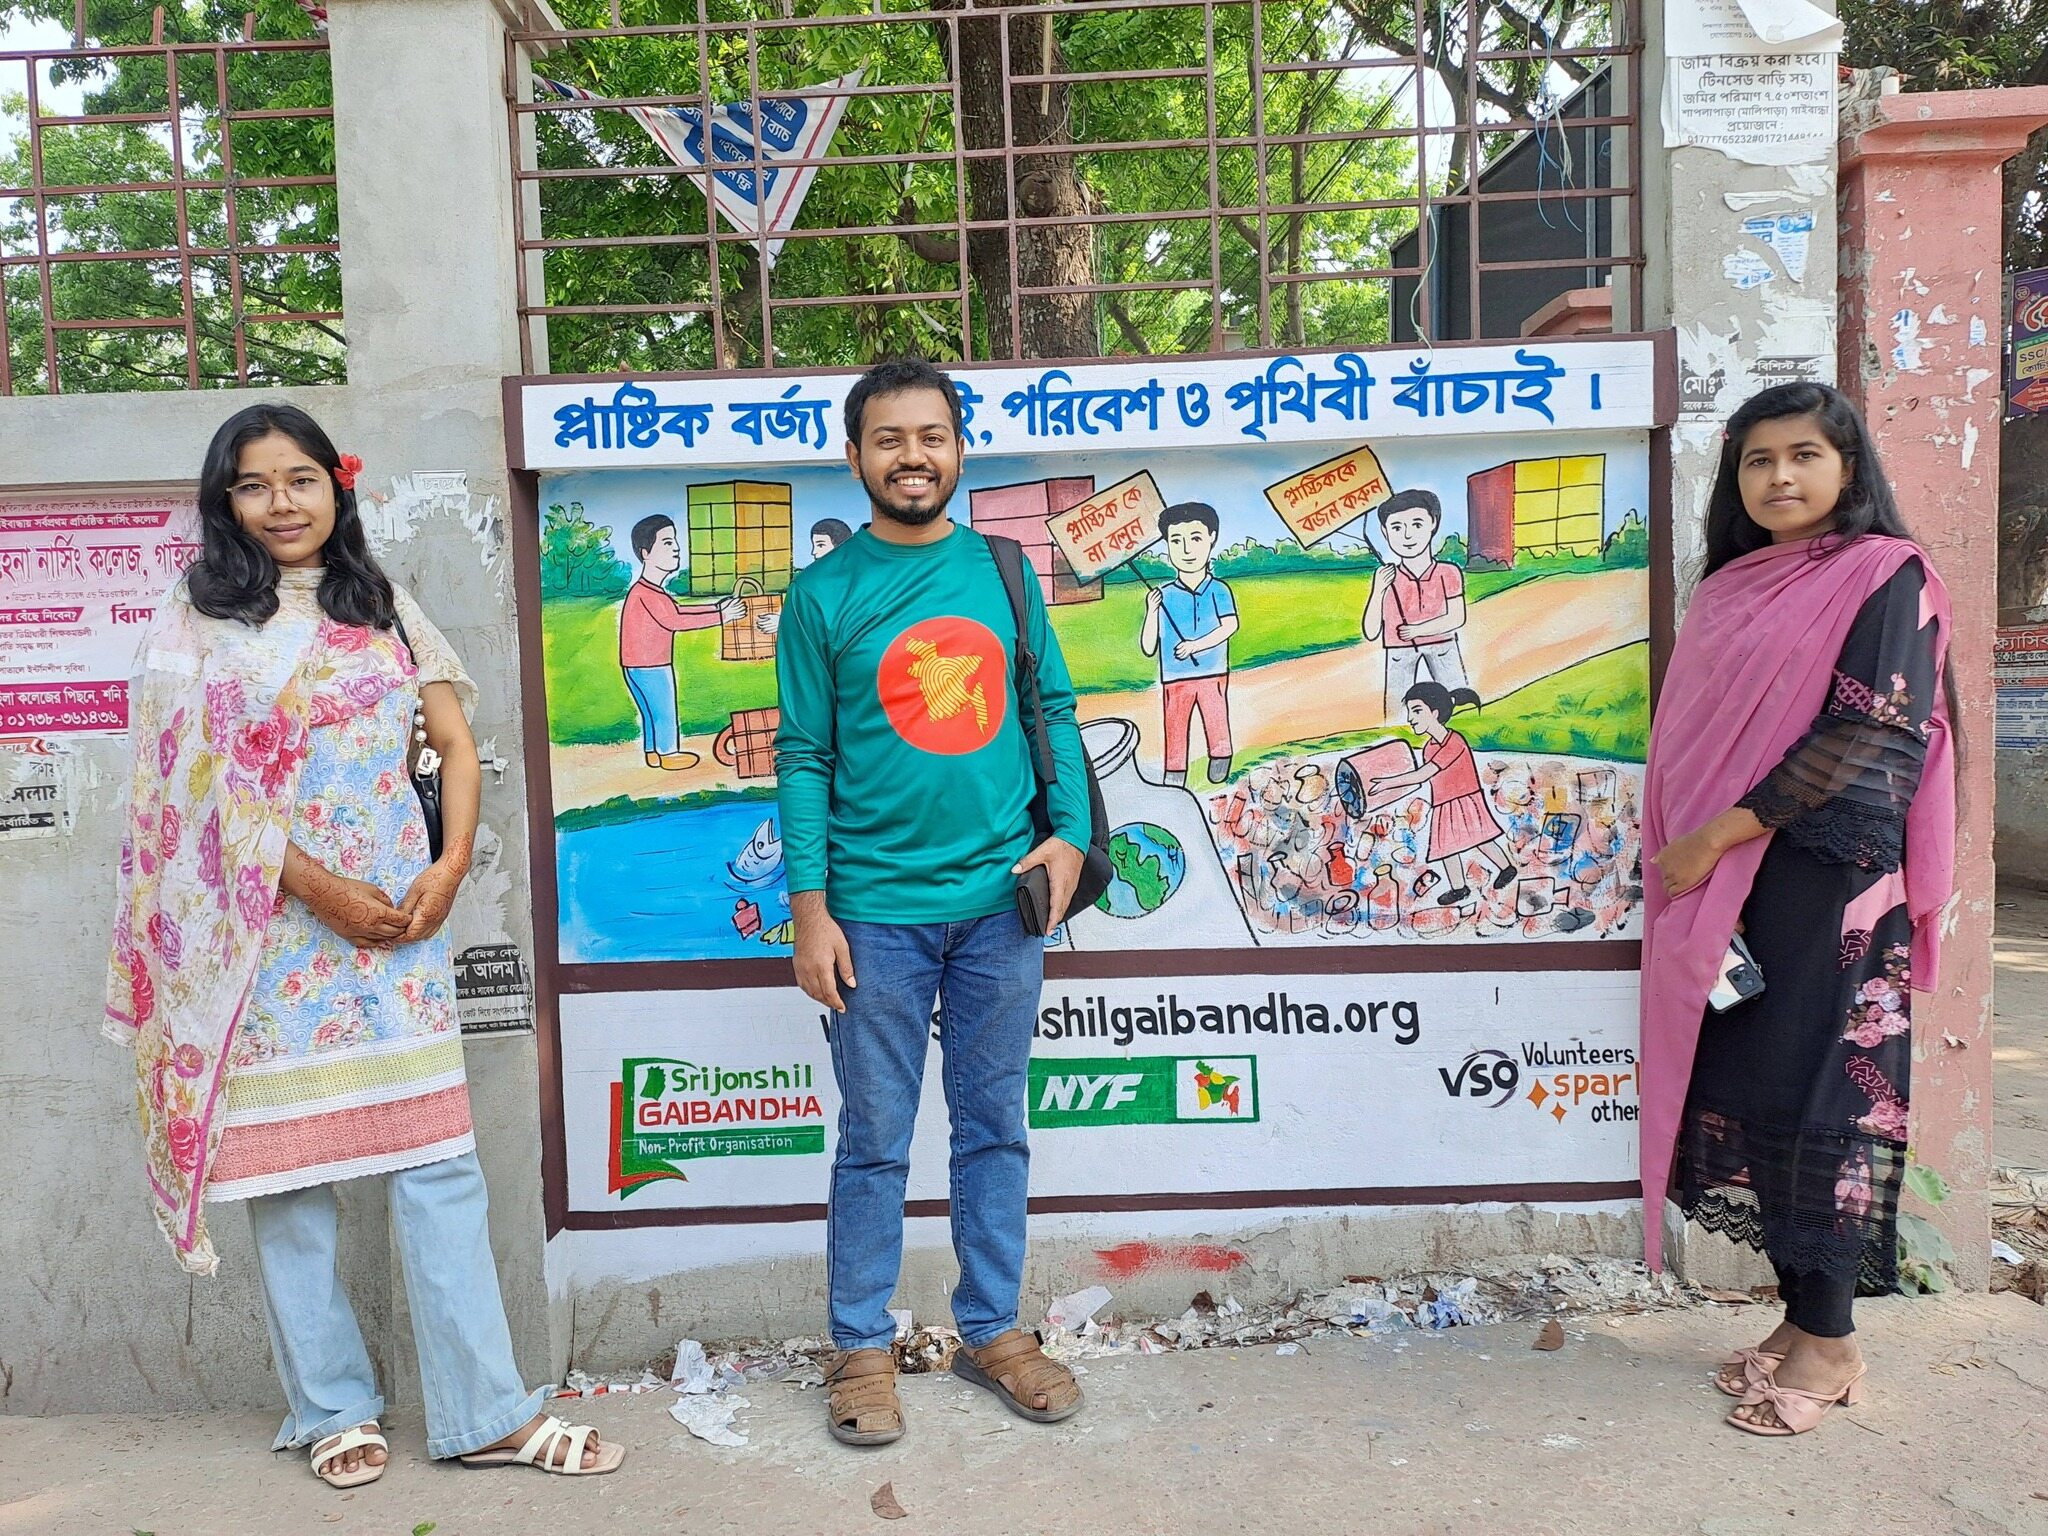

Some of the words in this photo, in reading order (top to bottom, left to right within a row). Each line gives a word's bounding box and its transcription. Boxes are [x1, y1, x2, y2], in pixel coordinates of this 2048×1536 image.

[1698, 71, 1753, 89] (টিনসেড
[1758, 70, 1786, 88] বাড়ি
[1790, 73, 1813, 87] সহ)
[1683, 91, 1717, 104] জমির
[728, 384, 832, 450] বর্জ্য
[1001, 370, 1165, 437] পরিবেশ
[1177, 382, 1211, 427] ও
[1225, 353, 1376, 442] পৃথিবী
[1391, 349, 1566, 425] বাঁচাই
[1122, 484, 1142, 510] কে
[1296, 501, 1342, 532] বর্জন
[1338, 477, 1384, 509] করুন
[1083, 540, 1108, 562] না
[1105, 516, 1145, 550] বলুন
[35, 532, 87, 582] নার্সিং
[86, 544, 149, 583] কলেজ,
[18, 690, 60, 706] কলেজের
[63, 686, 100, 707] পিছনে,
[102, 685, 122, 702] শনি
[471, 960, 515, 980] আলম
[672, 1064, 813, 1097] Srijonshil
[1039, 1074, 1143, 1111] NYF
[1553, 1062, 1640, 1105] spar
[639, 1096, 823, 1126] GAIBANDHA
[639, 1137, 705, 1155] Non-Profit
[710, 1134, 793, 1154] Organisation
